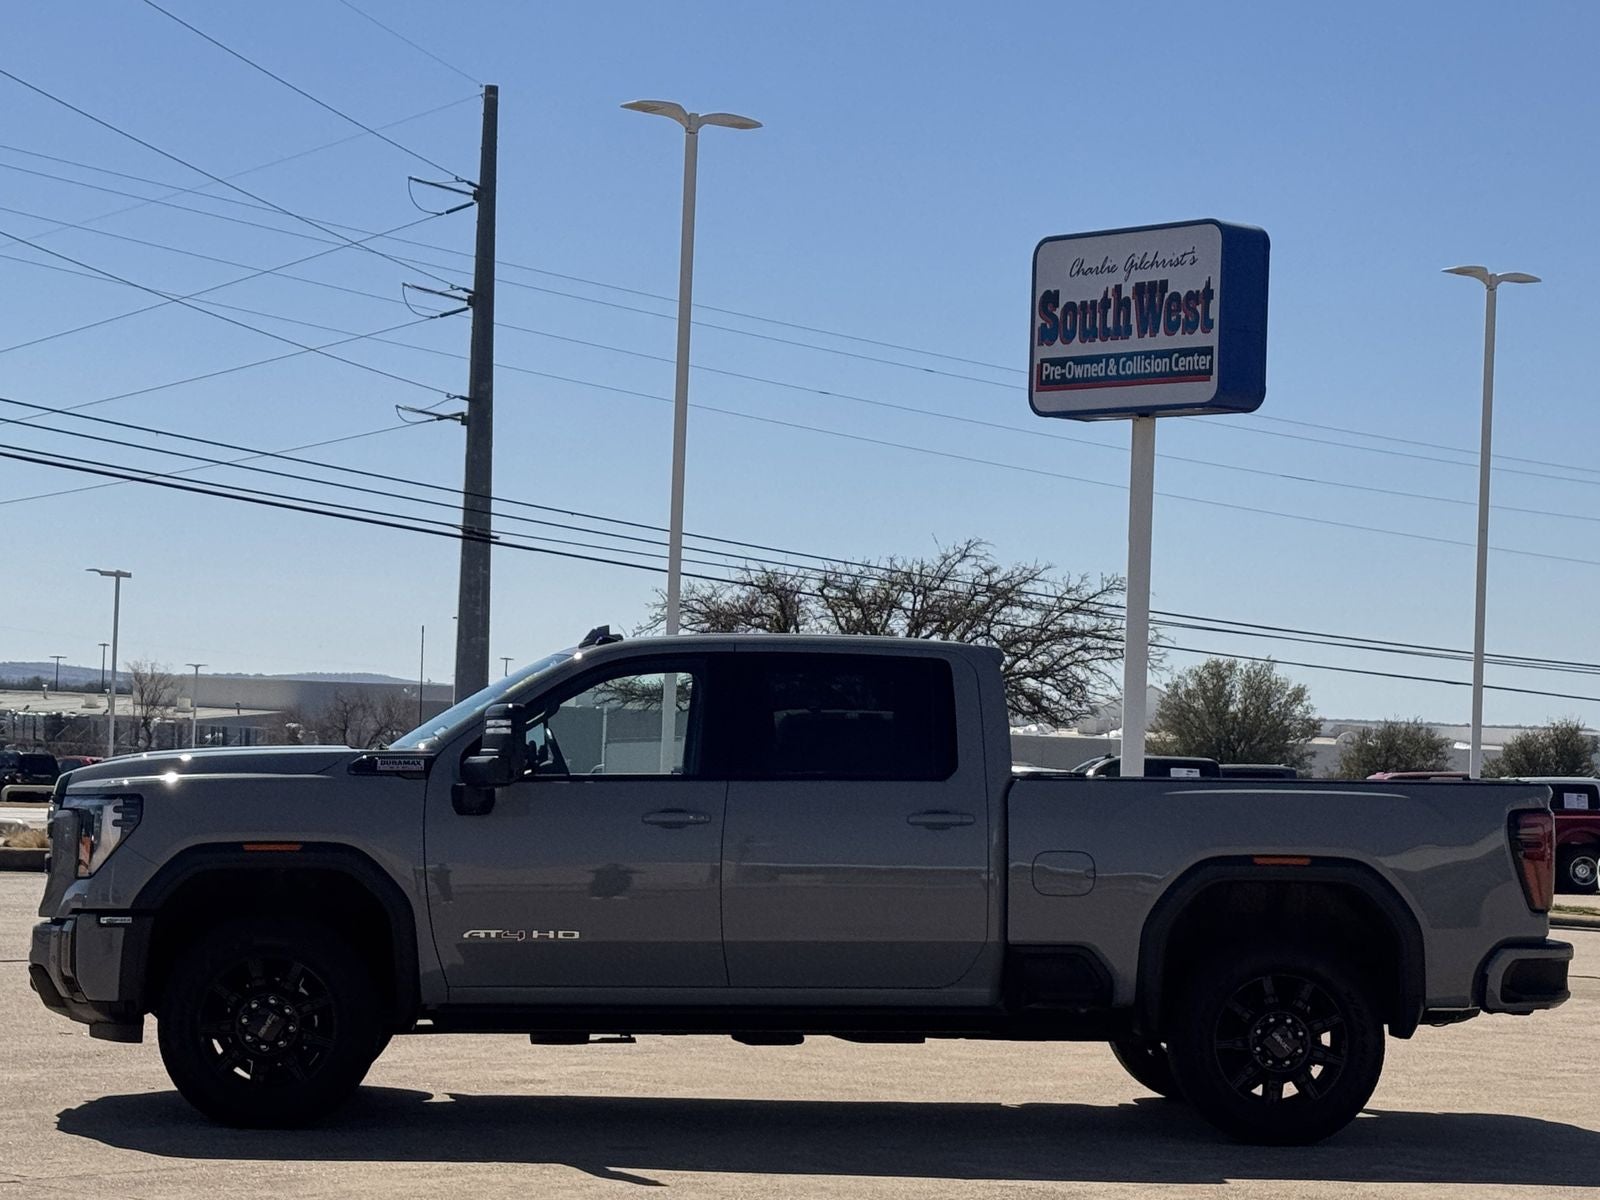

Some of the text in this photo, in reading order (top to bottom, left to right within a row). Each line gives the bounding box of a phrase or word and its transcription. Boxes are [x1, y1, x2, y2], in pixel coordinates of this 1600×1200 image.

[1069, 246, 1198, 282] Charlie Gilchrist's
[1037, 276, 1214, 346] SouthWest
[1041, 352, 1212, 381] Pre-Owned & Collision Center
[463, 929, 580, 942] AT4 HD
